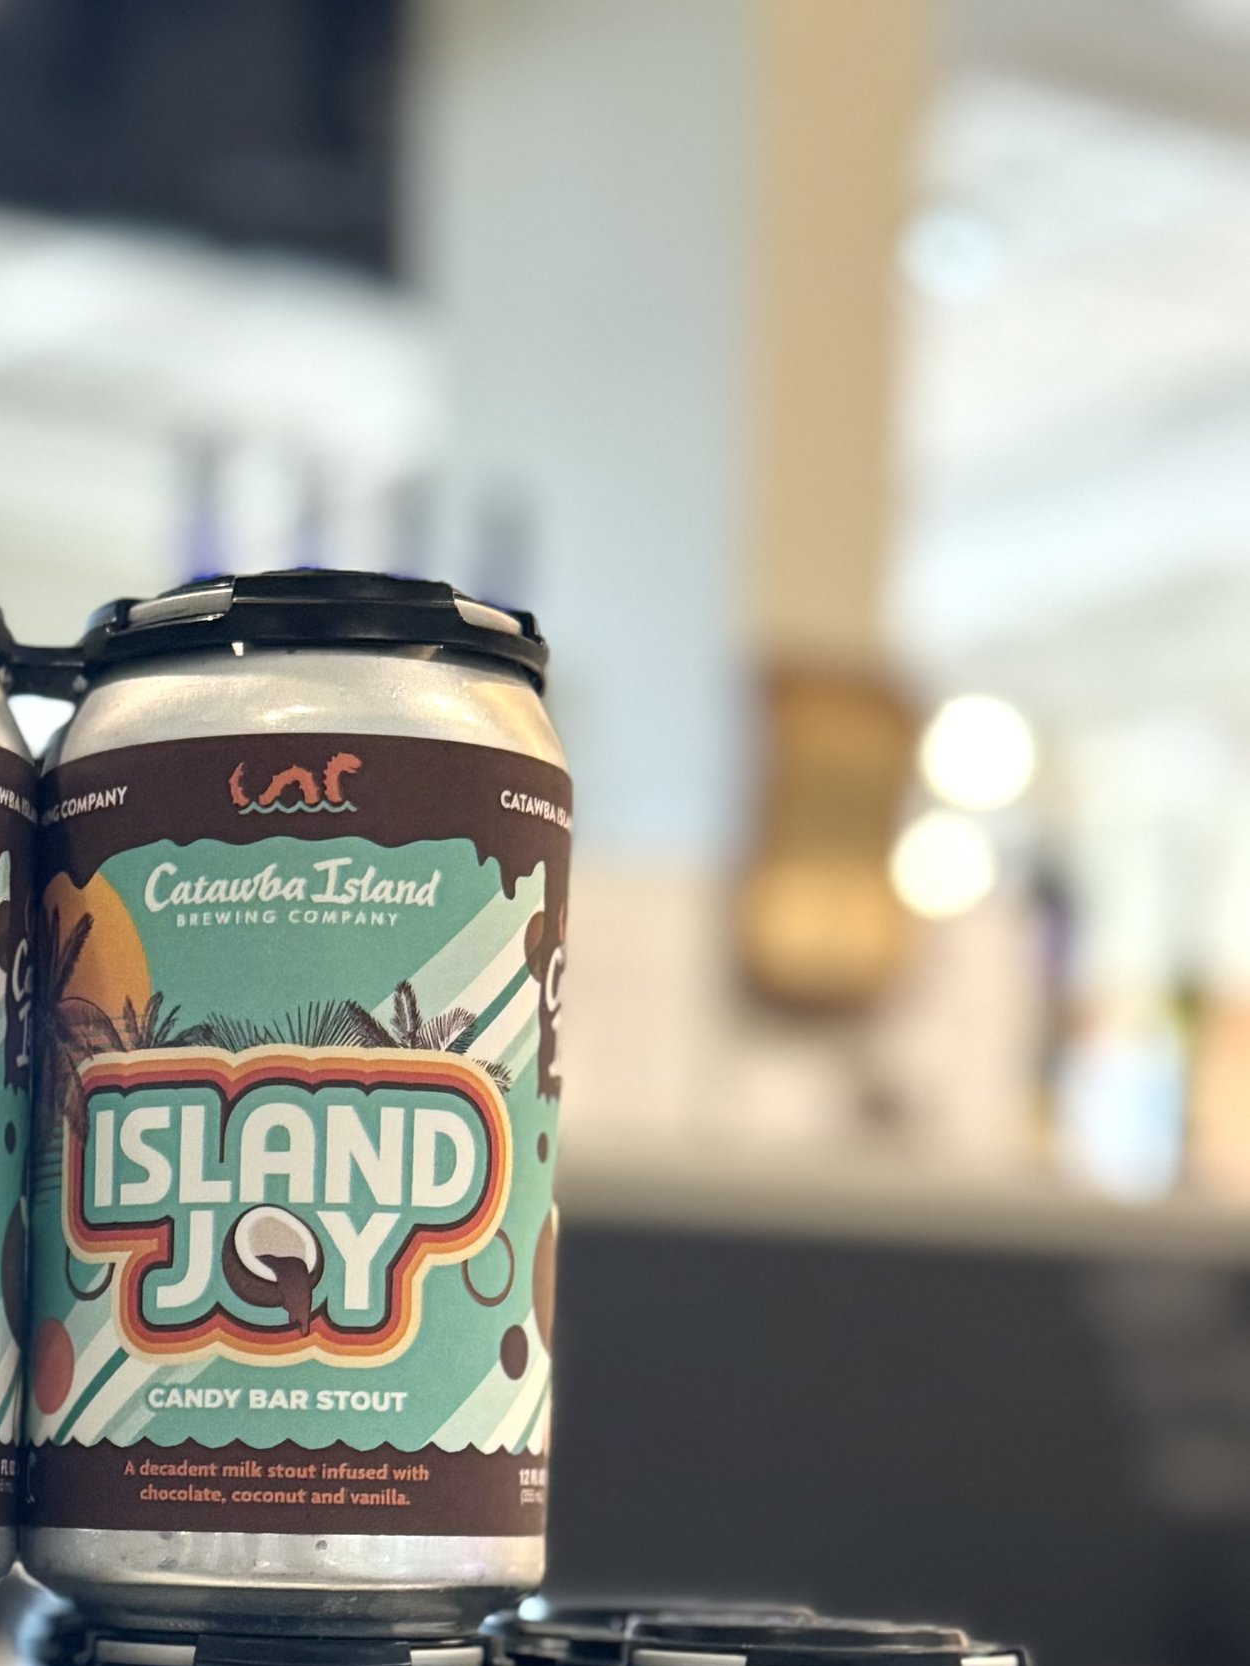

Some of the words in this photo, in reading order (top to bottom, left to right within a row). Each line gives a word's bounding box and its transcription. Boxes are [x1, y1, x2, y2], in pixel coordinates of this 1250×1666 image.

[61, 786, 128, 818] COMPANY
[500, 790, 556, 823] CATAWBA
[144, 862, 307, 912] Catawba
[310, 857, 441, 907] Island
[176, 910, 277, 927] BREWING
[288, 910, 398, 926] COMPANY
[93, 1102, 476, 1208] ISLAND
[156, 1203, 401, 1316] JOY
[149, 1388, 241, 1410] CANDY
[250, 1389, 307, 1410] BAR
[316, 1391, 408, 1412] STOUT
[123, 1460, 135, 1476] A
[139, 1460, 217, 1477] decadent
[222, 1461, 261, 1478] milk
[267, 1463, 316, 1480] stout
[322, 1463, 388, 1481] infused
[393, 1464, 430, 1482] with
[140, 1484, 226, 1504] chocolate,
[231, 1488, 306, 1504] coconut
[310, 1488, 345, 1505] and
[350, 1489, 411, 1506] vanilla.
